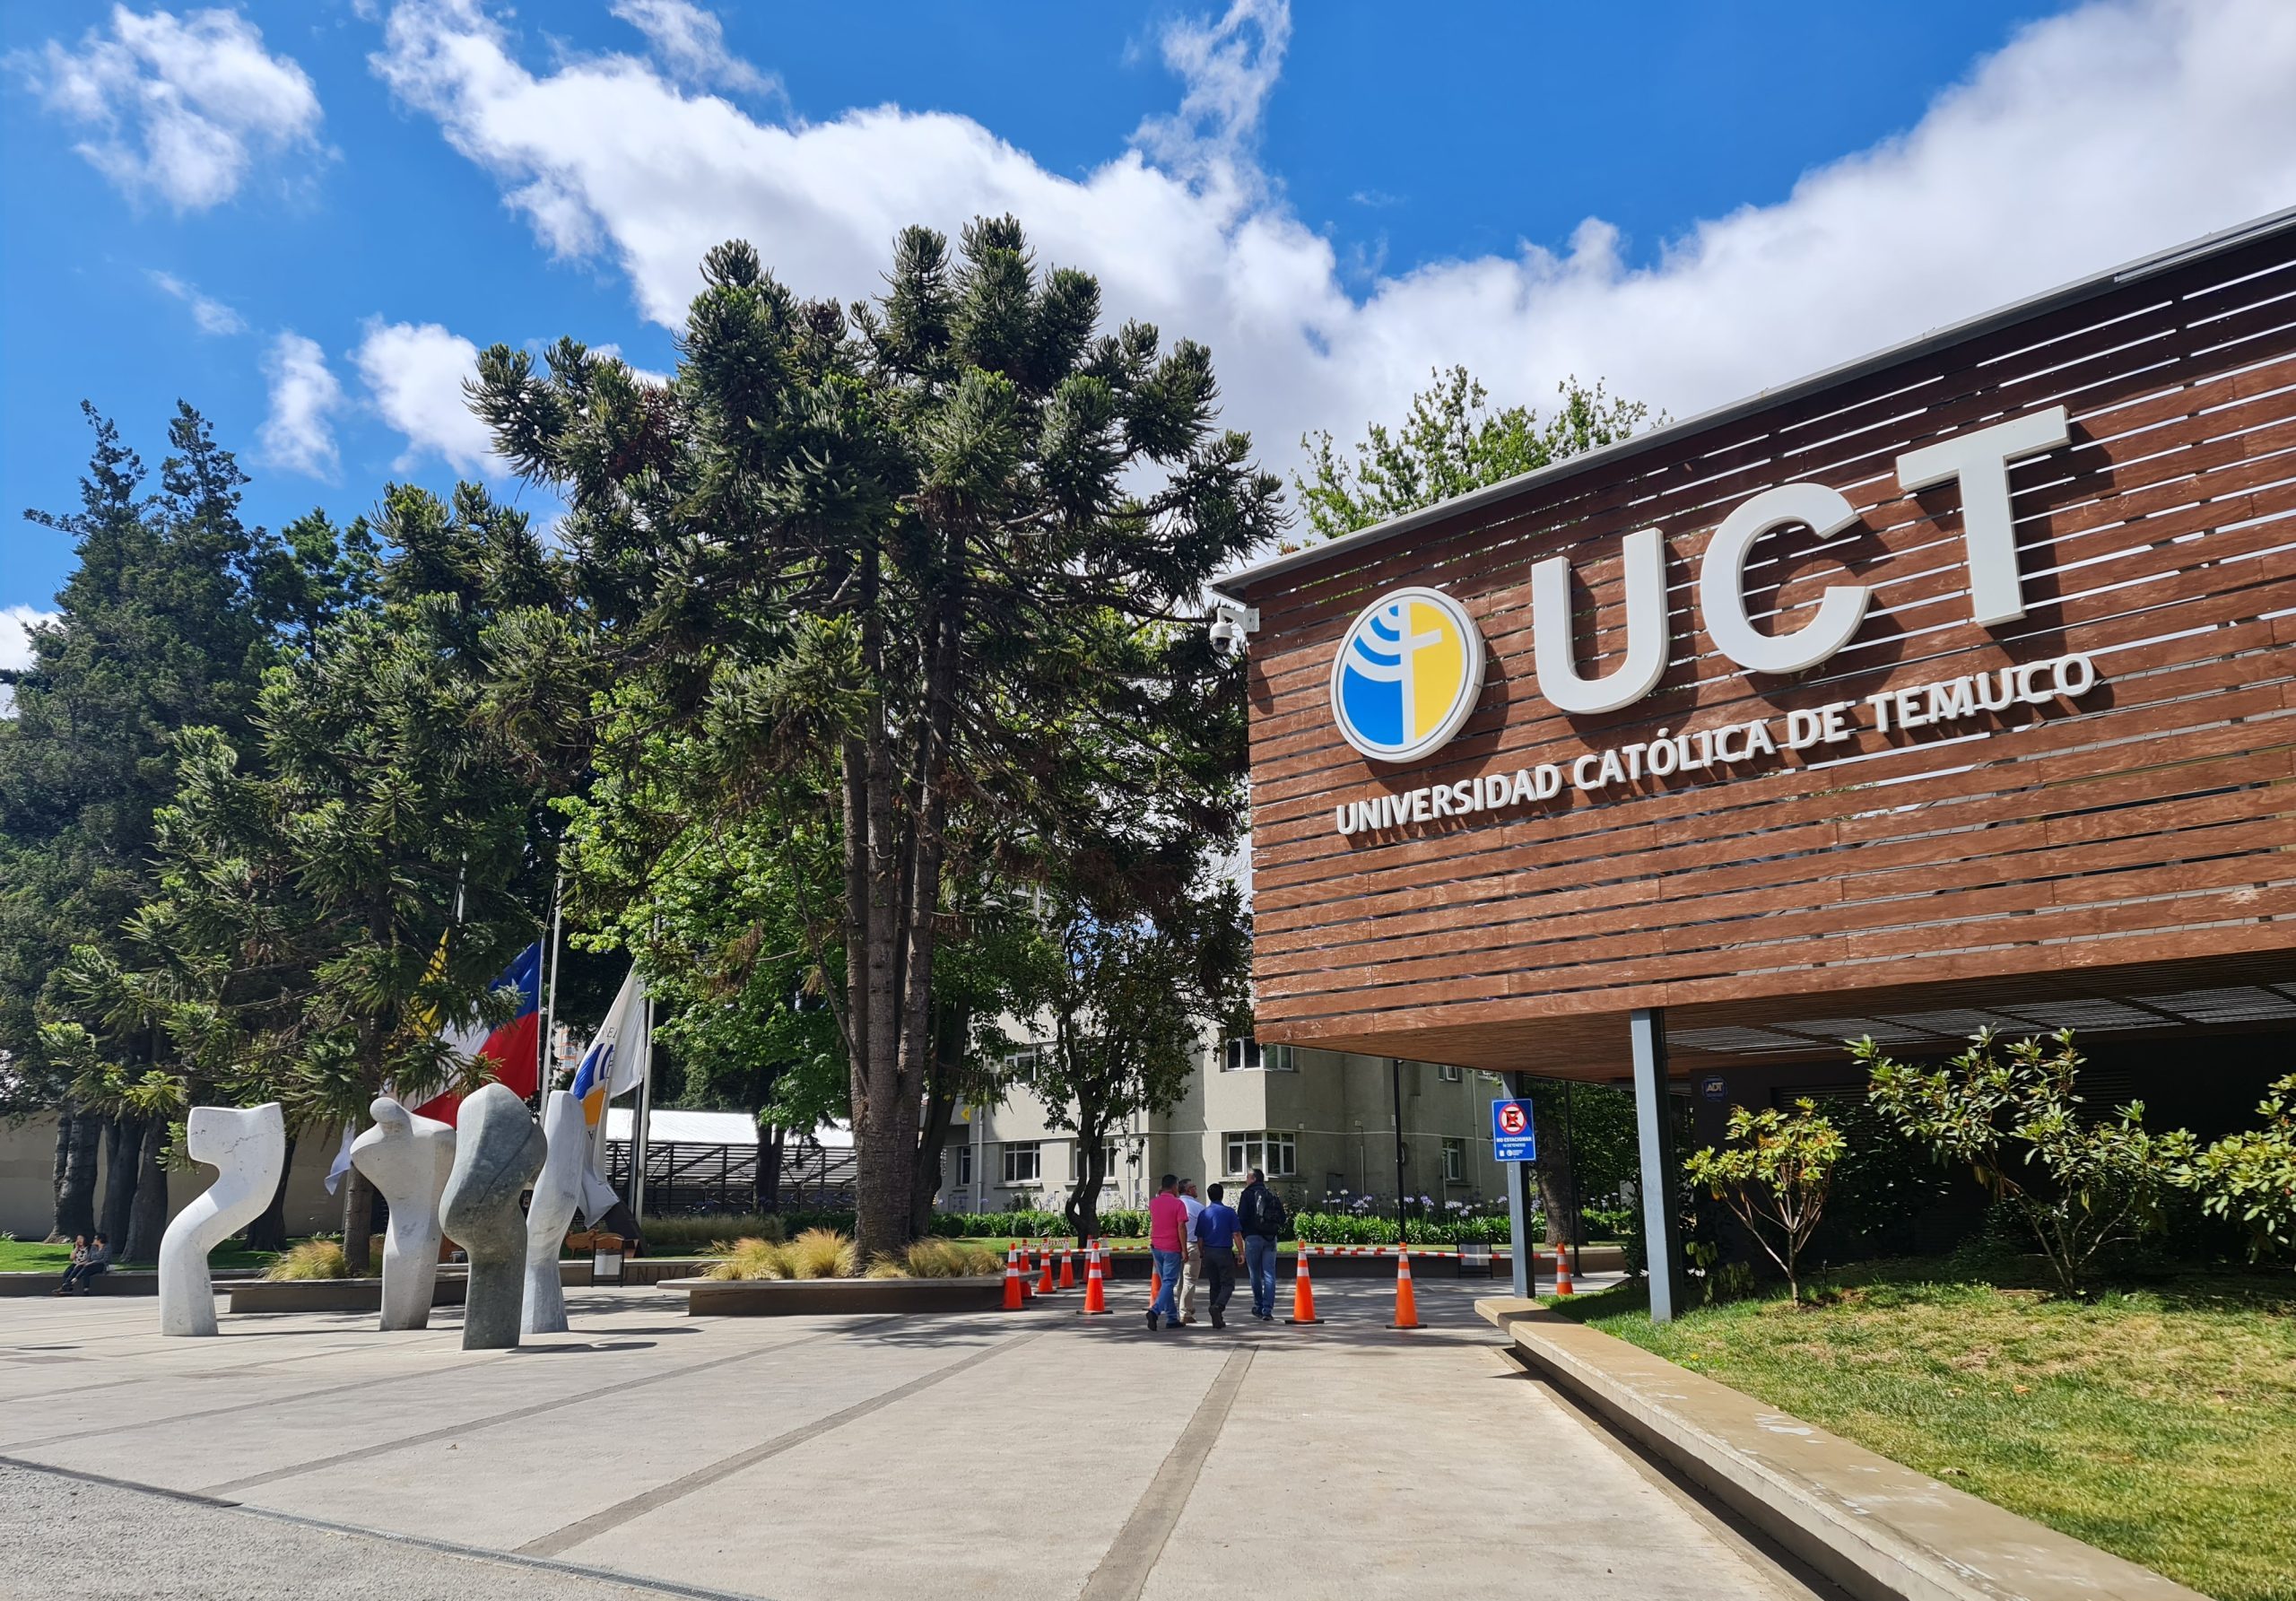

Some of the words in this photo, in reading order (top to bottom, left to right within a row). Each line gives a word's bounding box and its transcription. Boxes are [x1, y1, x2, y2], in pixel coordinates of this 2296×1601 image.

[1532, 405, 2073, 714] UCT
[1336, 764, 1563, 835] UNIVERSIDAD
[1573, 719, 1777, 790] CATÓLICA
[1787, 701, 1850, 749] DE
[1866, 652, 2096, 733] TEMUCO
[1706, 1082, 1723, 1092] ADT
